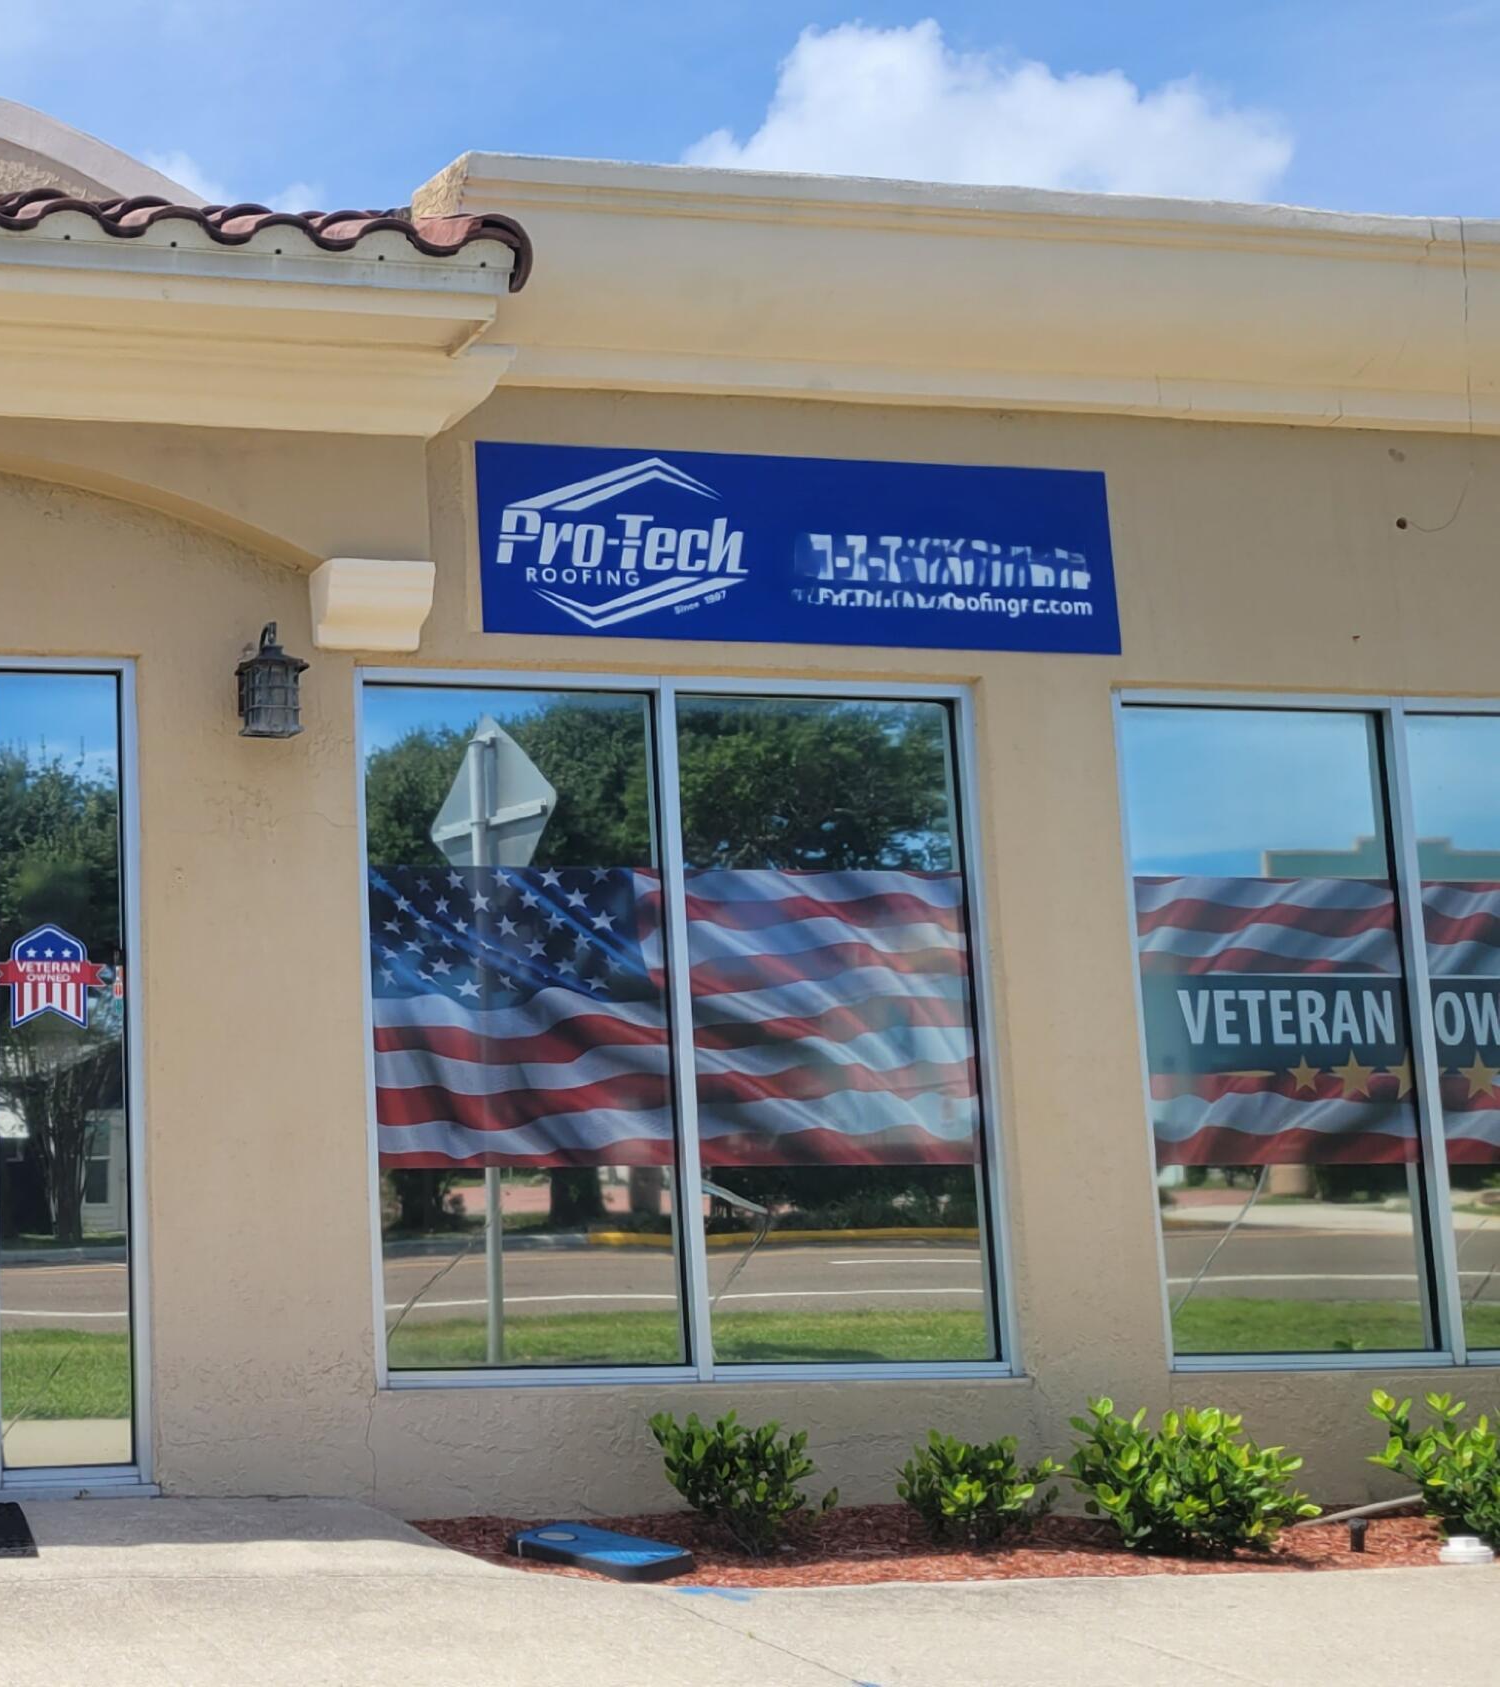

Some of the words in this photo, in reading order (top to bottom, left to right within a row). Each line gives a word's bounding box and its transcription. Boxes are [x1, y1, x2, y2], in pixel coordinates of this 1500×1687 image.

[496, 509, 749, 574] Pro-Tech
[525, 566, 641, 587] ROOFING
[17, 961, 81, 974] VETERAN
[26, 974, 71, 983] OWNED
[1176, 989, 1397, 1046] VETERAN
